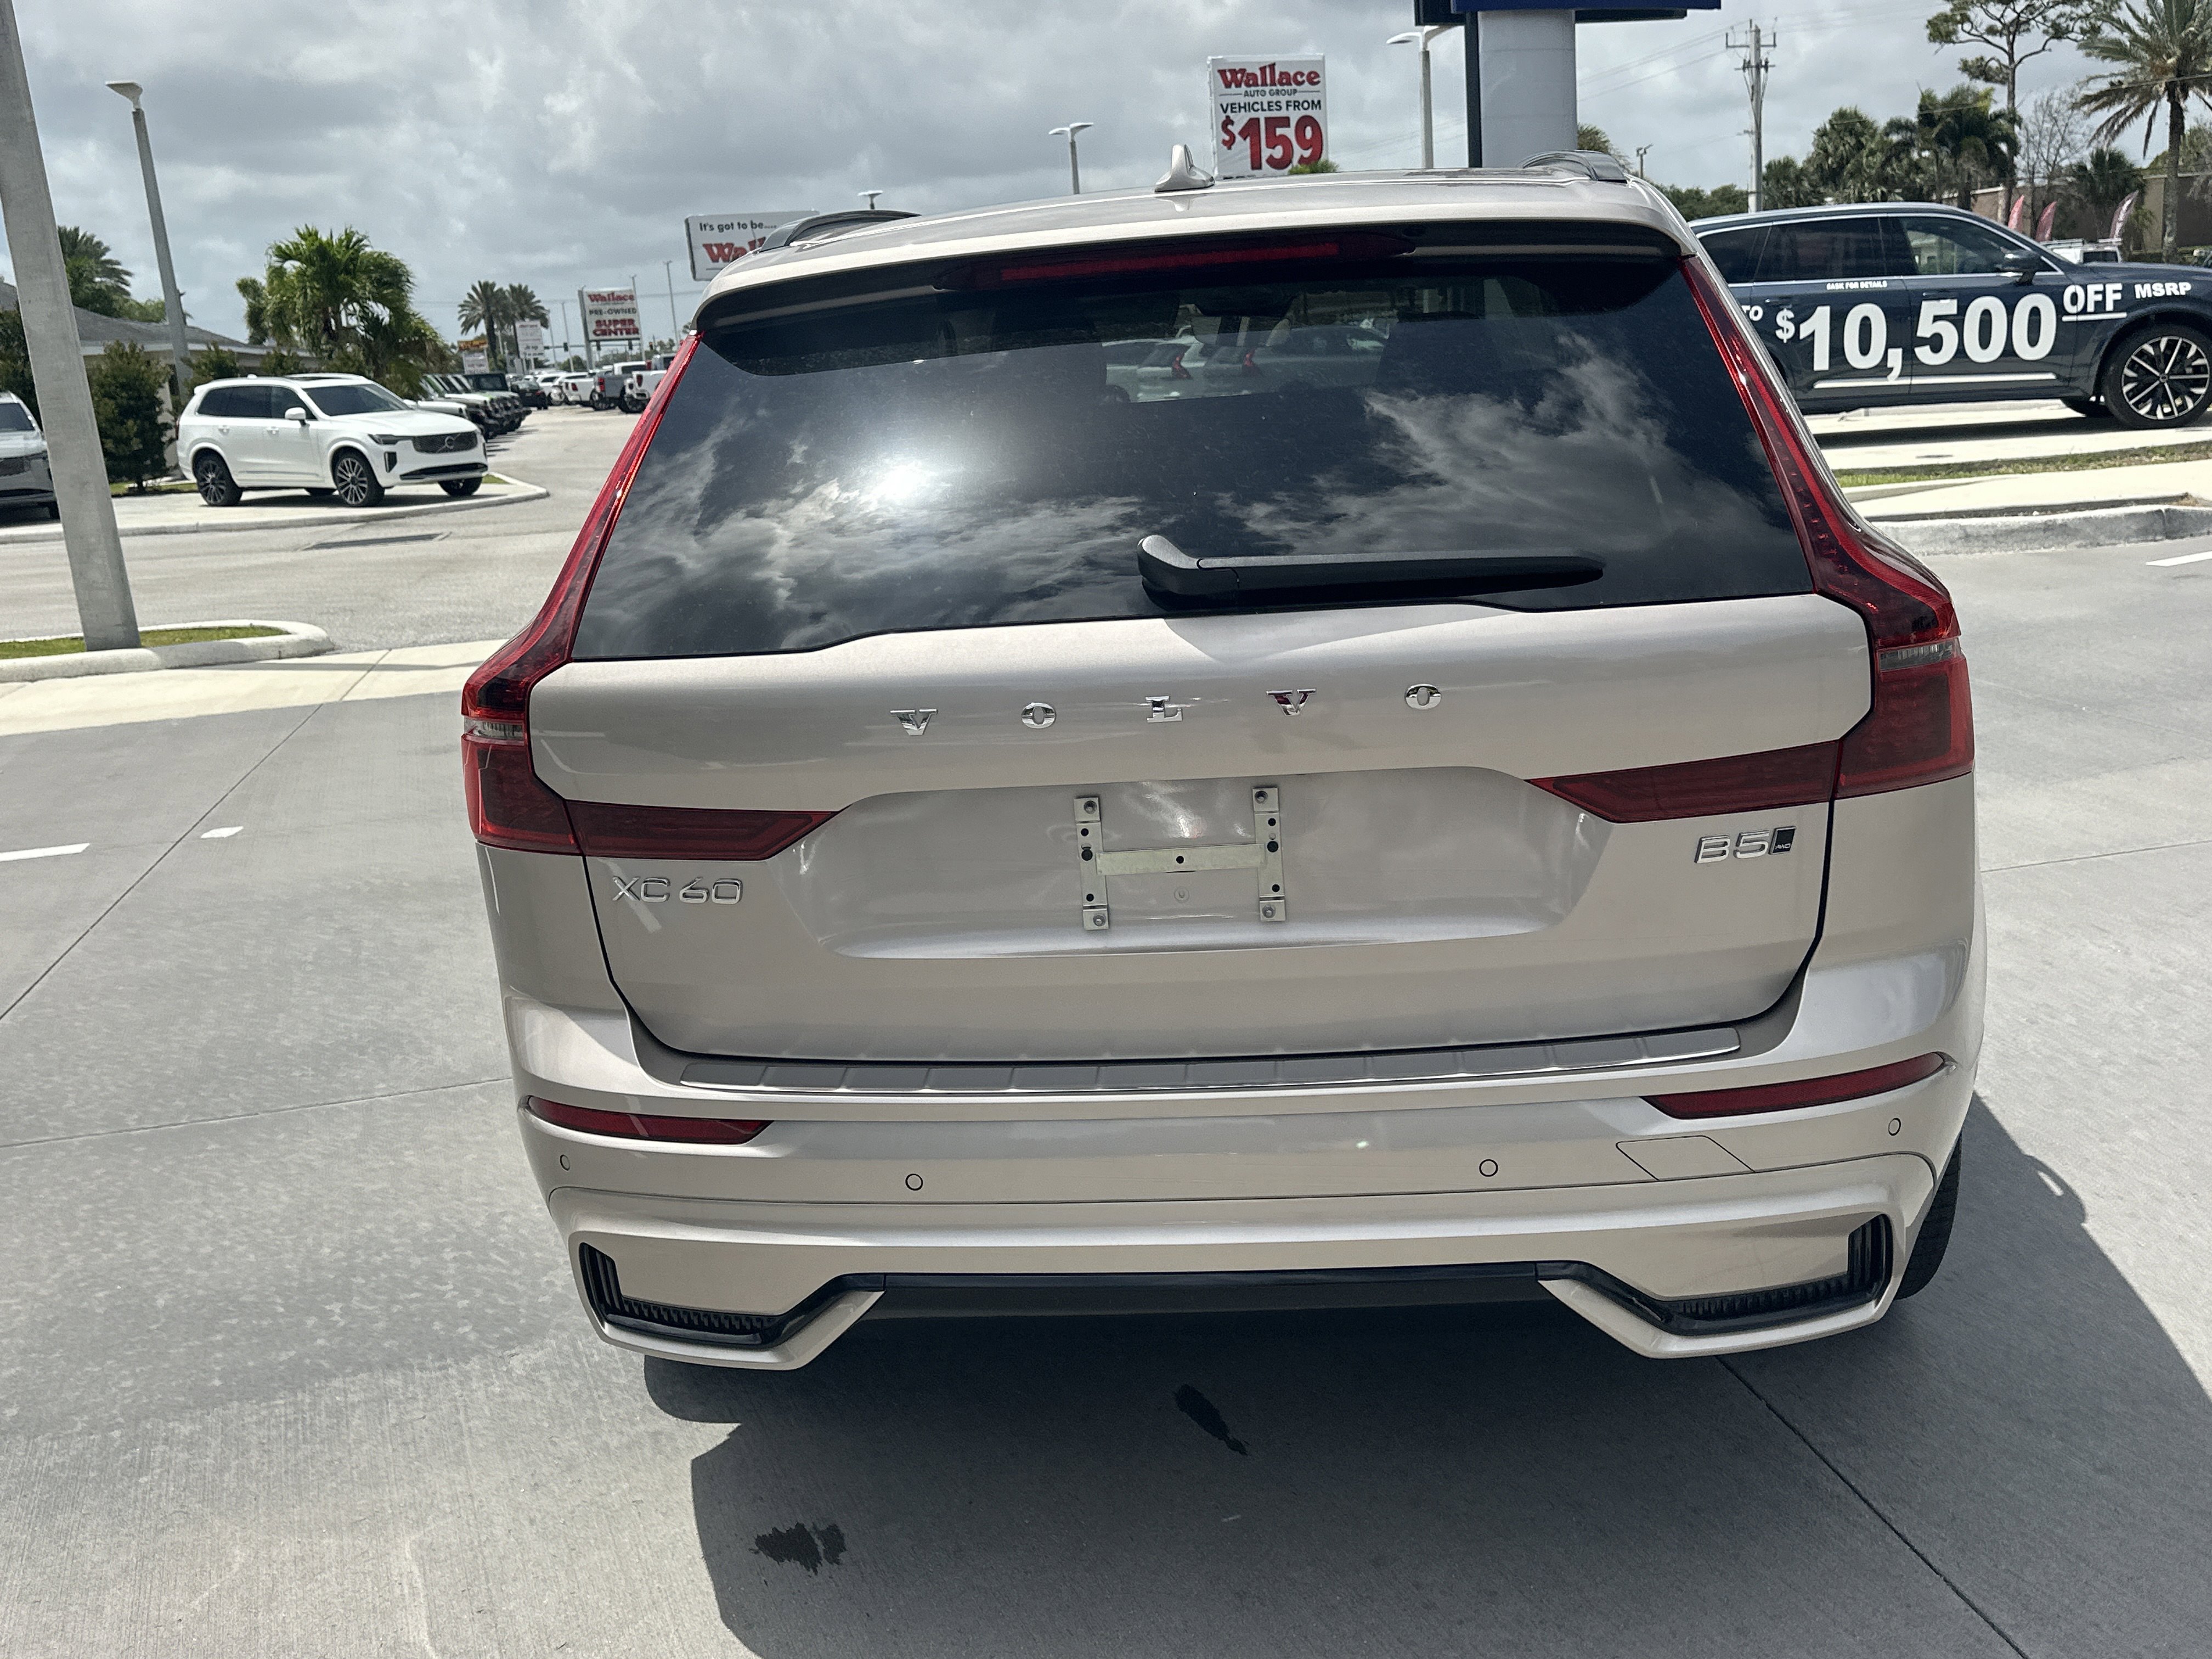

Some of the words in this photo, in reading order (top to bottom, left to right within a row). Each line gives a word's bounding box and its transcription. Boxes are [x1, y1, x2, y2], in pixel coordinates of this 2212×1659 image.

[1217, 62, 1321, 89] Wallace
[1243, 89, 1267, 98] AUTO
[1268, 88, 1297, 97] GROUP
[1220, 101, 1283, 114] VEHICLES
[1285, 99, 1322, 111] FROM
[1221, 115, 1323, 171] $159
[699, 222, 714, 231] It's
[718, 222, 733, 233] got
[737, 222, 748, 230] to
[588, 291, 635, 302] Wallace
[2063, 283, 2123, 314] OFF
[2134, 281, 2192, 299] MSRP
[592, 328, 639, 336] CENTER
[595, 319, 635, 328] SUPER
[1775, 292, 2057, 381] $10,500
[890, 684, 1442, 736] VOLVO
[1694, 829, 1769, 864] B5
